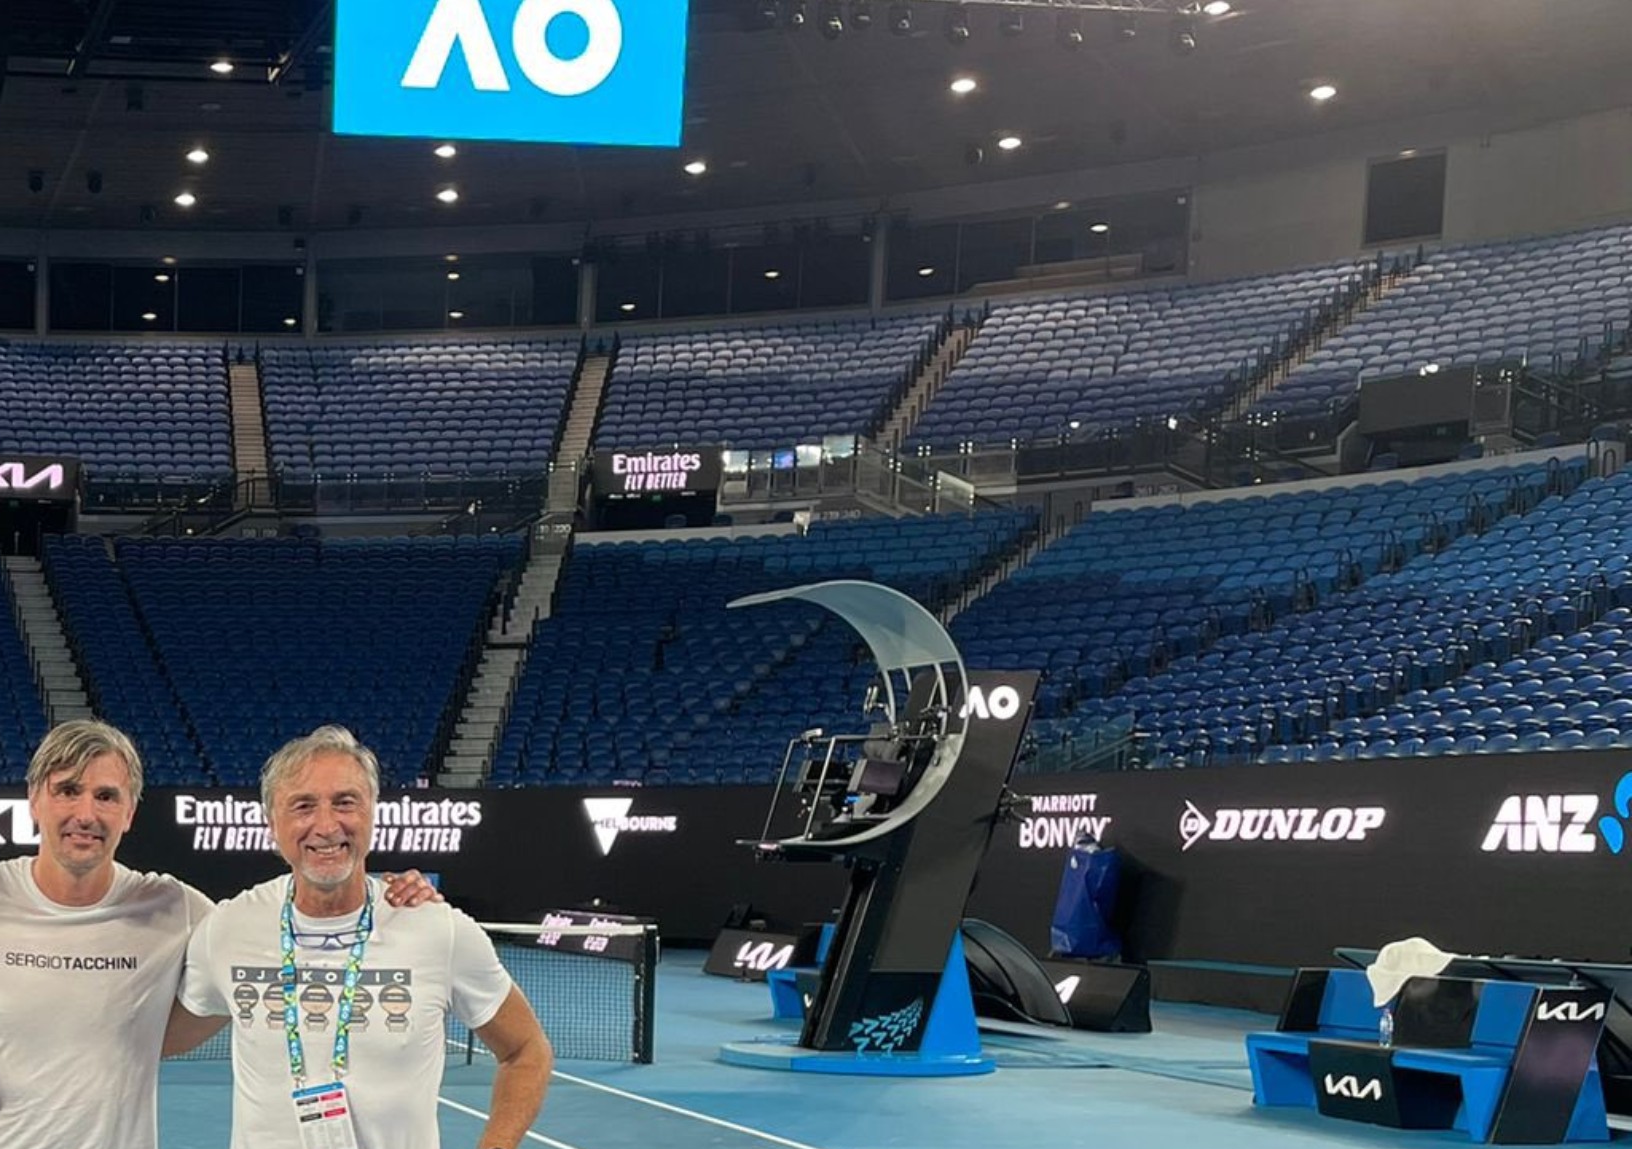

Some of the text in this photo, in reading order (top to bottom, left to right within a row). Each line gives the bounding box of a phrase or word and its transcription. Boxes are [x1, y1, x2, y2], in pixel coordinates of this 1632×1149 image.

[401, 0, 622, 96] AO
[612, 451, 701, 476] Emirates
[623, 470, 687, 491] FLY BETTER
[959, 685, 1020, 720] AO
[174, 794, 268, 825] Emira
[373, 795, 483, 827] mirates
[1031, 794, 1098, 813] MARRIOTT
[1208, 807, 1386, 840] DUNLOP
[1481, 794, 1599, 852] ANZ
[193, 826, 277, 851] FLY BETTE
[370, 827, 462, 852] FLY BETTER
[1537, 1001, 1605, 1021] KIA
[1325, 1073, 1382, 1101] KIA
